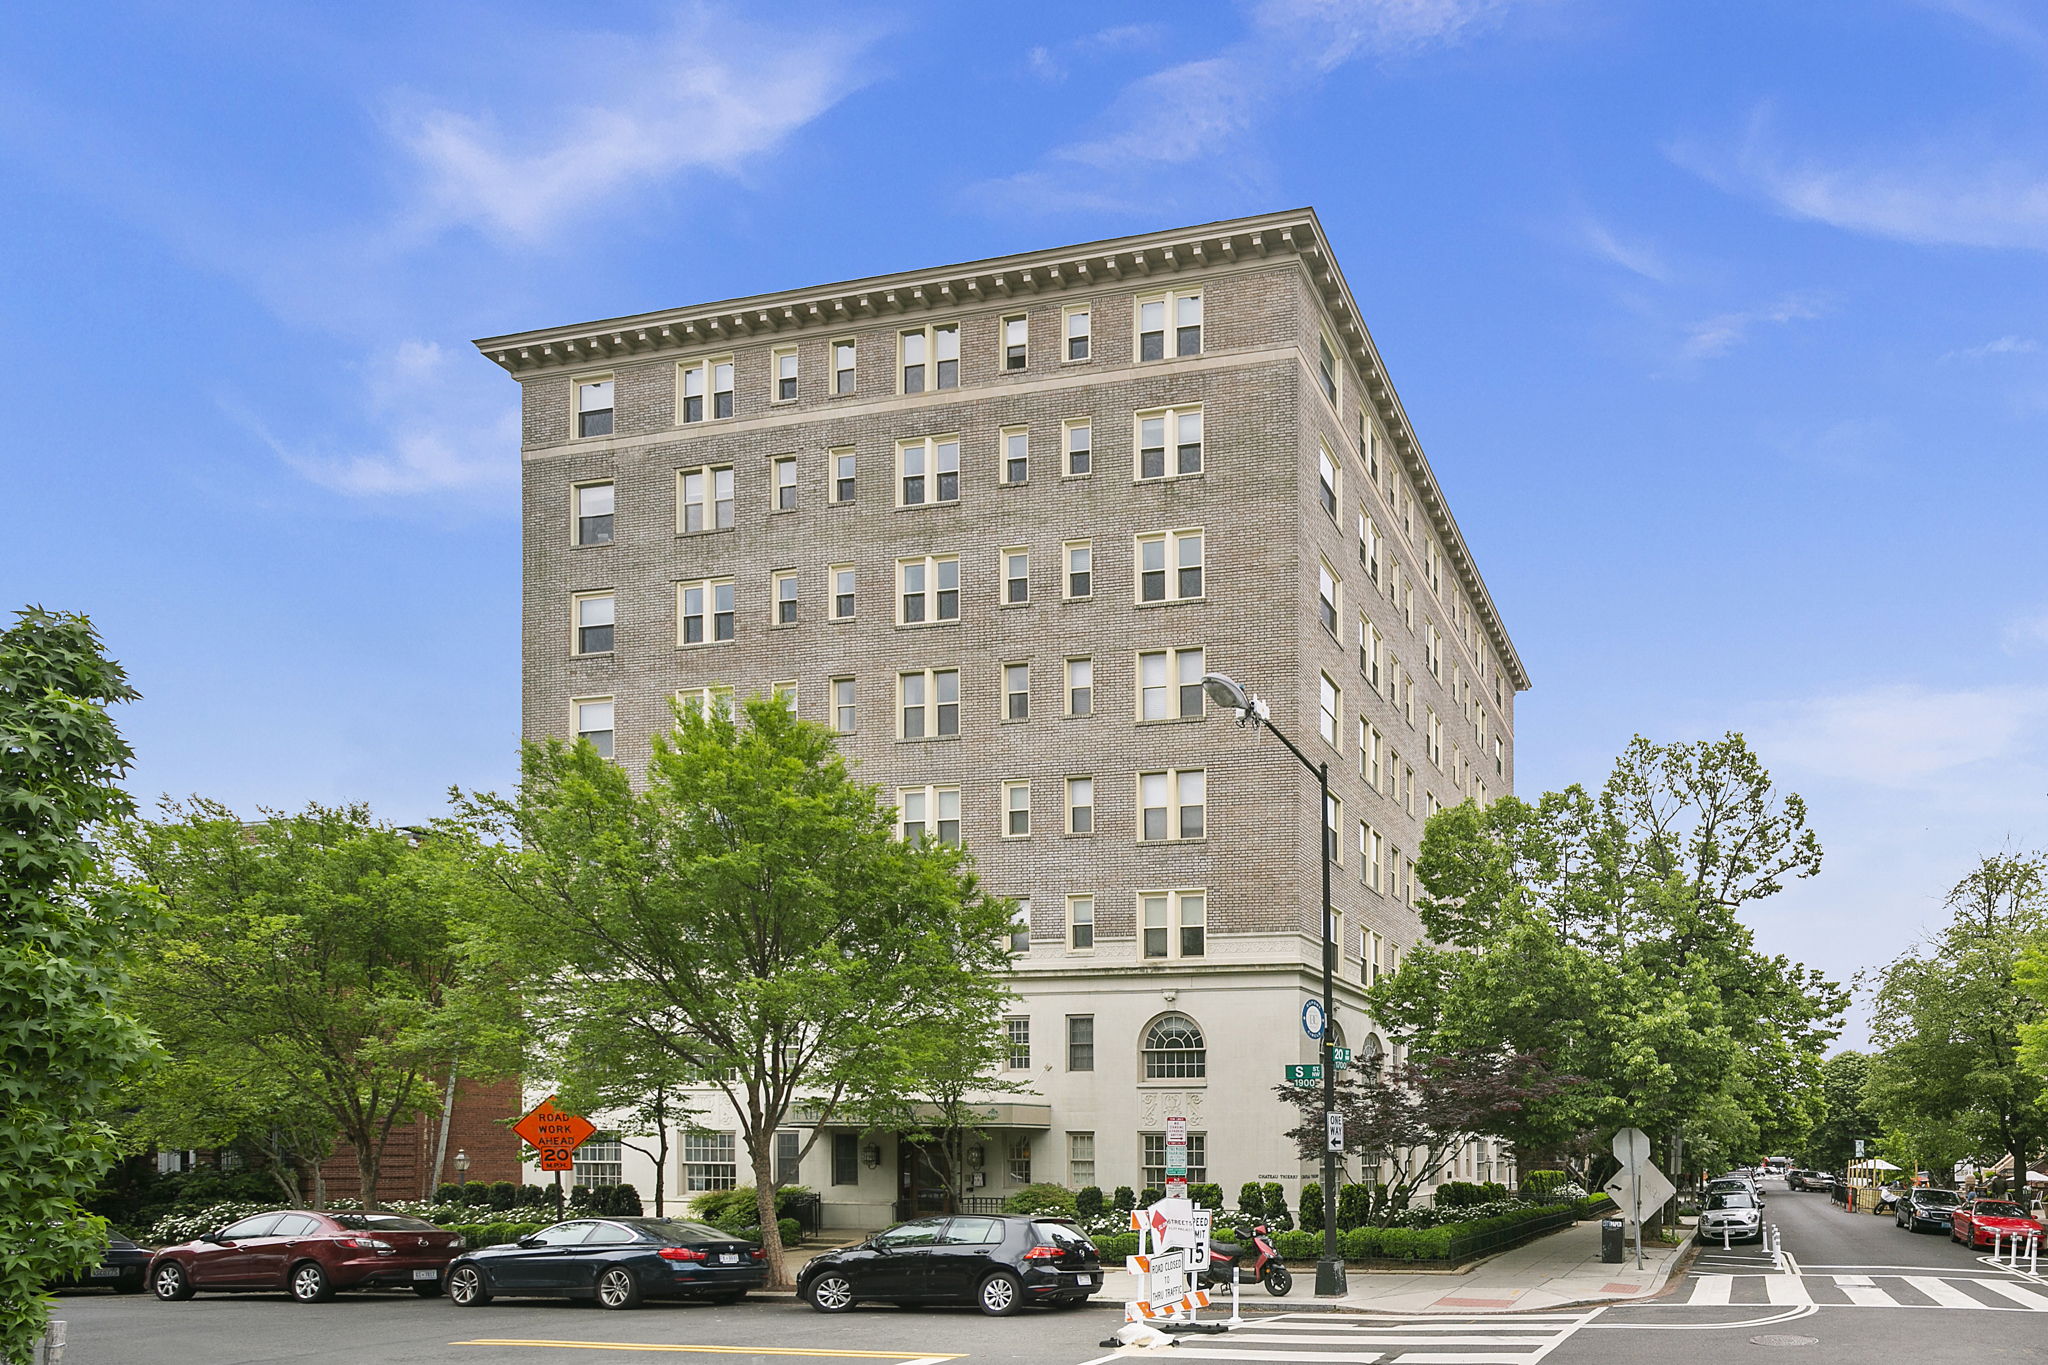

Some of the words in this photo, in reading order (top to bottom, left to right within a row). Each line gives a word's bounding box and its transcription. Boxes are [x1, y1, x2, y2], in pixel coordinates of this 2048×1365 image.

[1334, 1048, 1343, 1060] 20
[1295, 1066, 1304, 1078] S
[1295, 1079, 1315, 1087] 1900
[538, 1113, 570, 1122] ROAD
[1330, 1115, 1342, 1125] ONE
[538, 1125, 572, 1134] WORK
[1330, 1126, 1342, 1135] WAY
[538, 1137, 575, 1145] AHEAD
[543, 1149, 569, 1161] 20
[1193, 1217, 1208, 1227] PEED
[1195, 1230, 1206, 1239] MIT
[1189, 1242, 1204, 1264] 15
[1152, 1263, 1164, 1274] ROAD
[1164, 1259, 1181, 1271] CLOSED
[1164, 1275, 1170, 1284] TO
[1152, 1291, 1164, 1302] THRU
[1165, 1285, 1182, 1298] TRAFFIC
